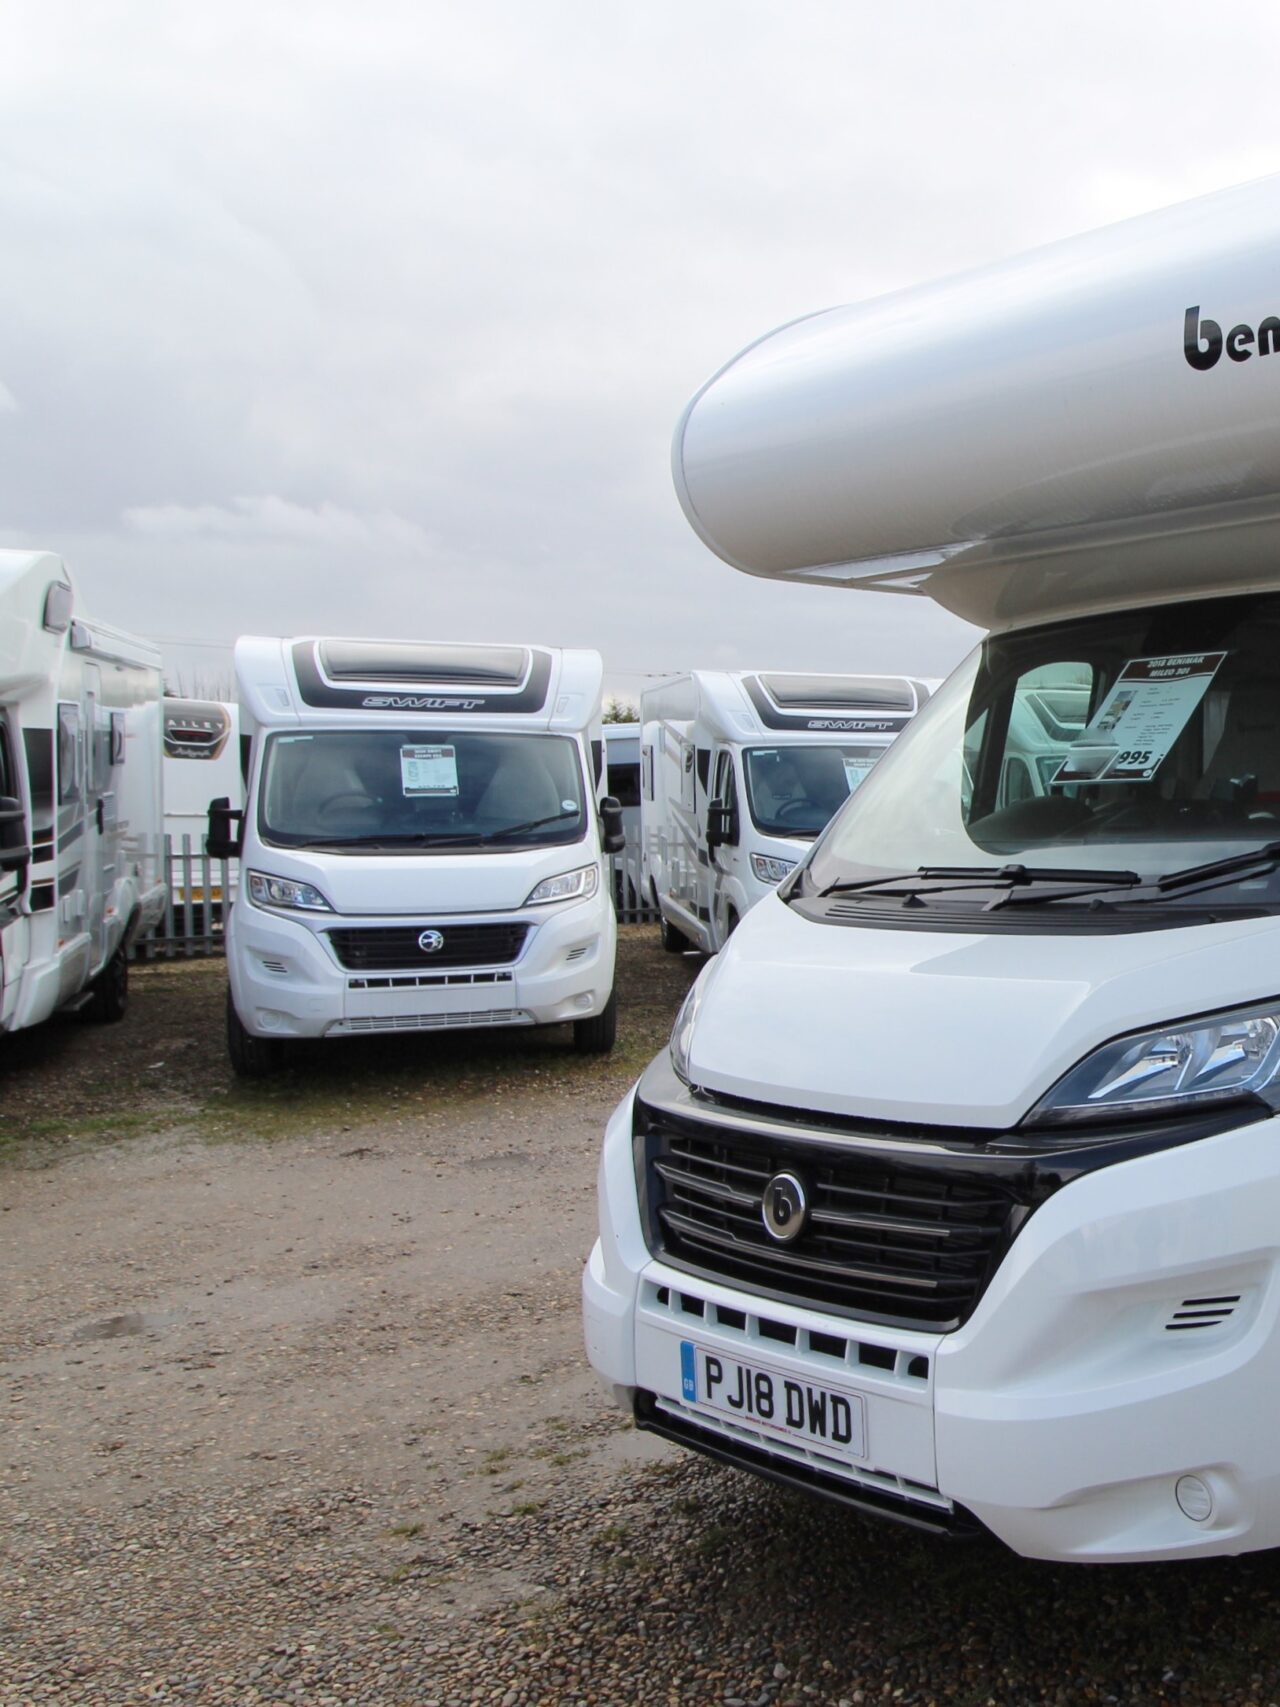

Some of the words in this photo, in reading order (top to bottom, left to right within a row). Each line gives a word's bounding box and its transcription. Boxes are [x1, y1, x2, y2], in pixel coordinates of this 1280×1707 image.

[1167, 656, 1205, 666] BENIMAR
[1149, 668, 1175, 677] MILEO
[1176, 667, 1191, 675] 301
[362, 696, 485, 710] SWIFT
[168, 720, 223, 728] AILEY
[808, 720, 893, 730] SWIFT
[683, 1378, 694, 1392] GB
[705, 1355, 774, 1419] PJ18
[784, 1381, 852, 1444] DWD
